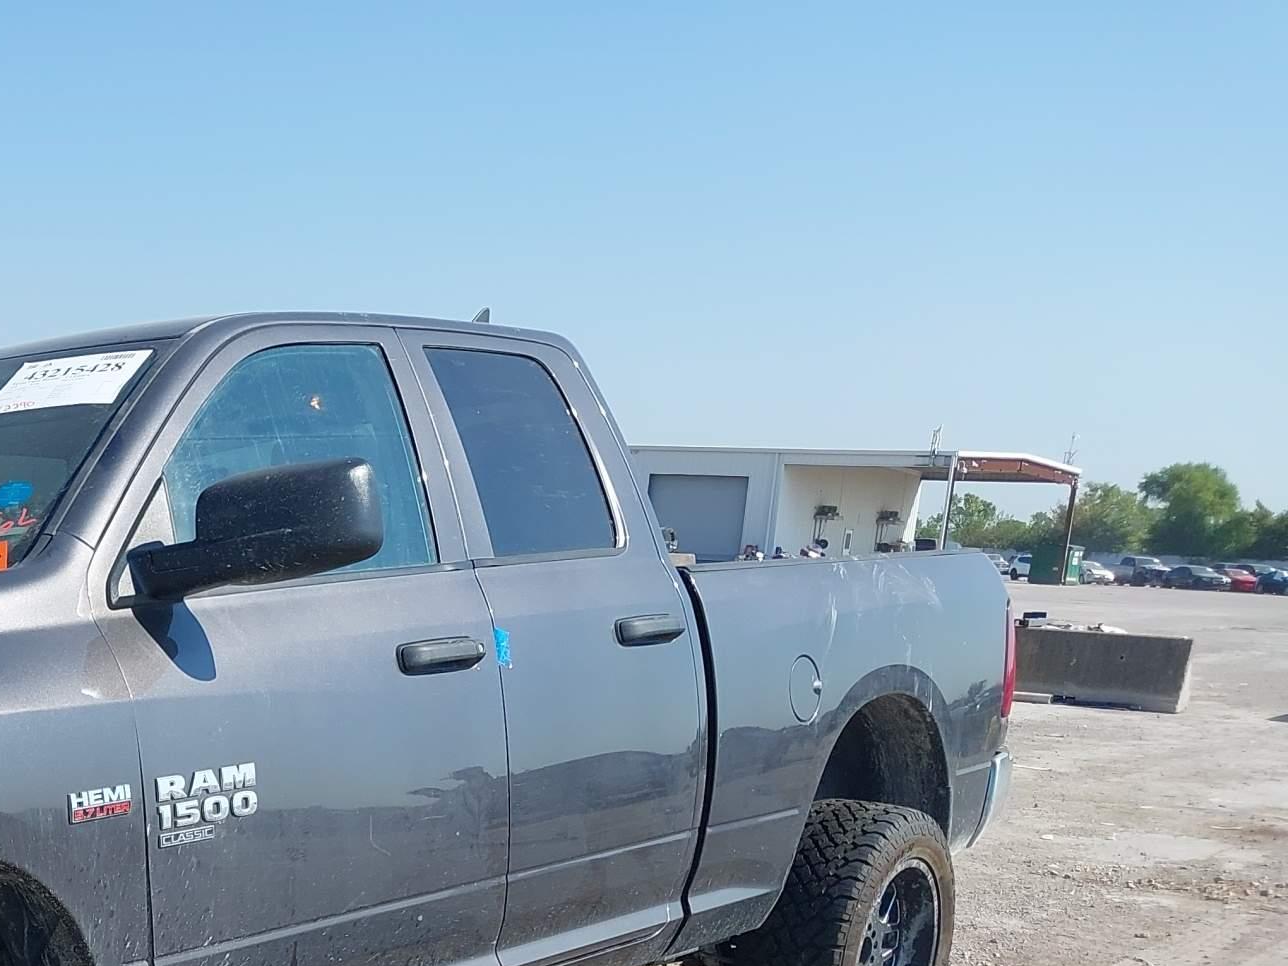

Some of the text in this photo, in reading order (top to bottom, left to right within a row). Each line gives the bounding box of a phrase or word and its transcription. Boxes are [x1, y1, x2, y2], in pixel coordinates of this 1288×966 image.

[24, 361, 125, 381] 43215428
[155, 762, 257, 802] RAM
[68, 784, 131, 809] HEMI
[96, 802, 129, 817] LITER
[157, 790, 258, 830] 1500
[162, 826, 214, 845] CLASSIC
